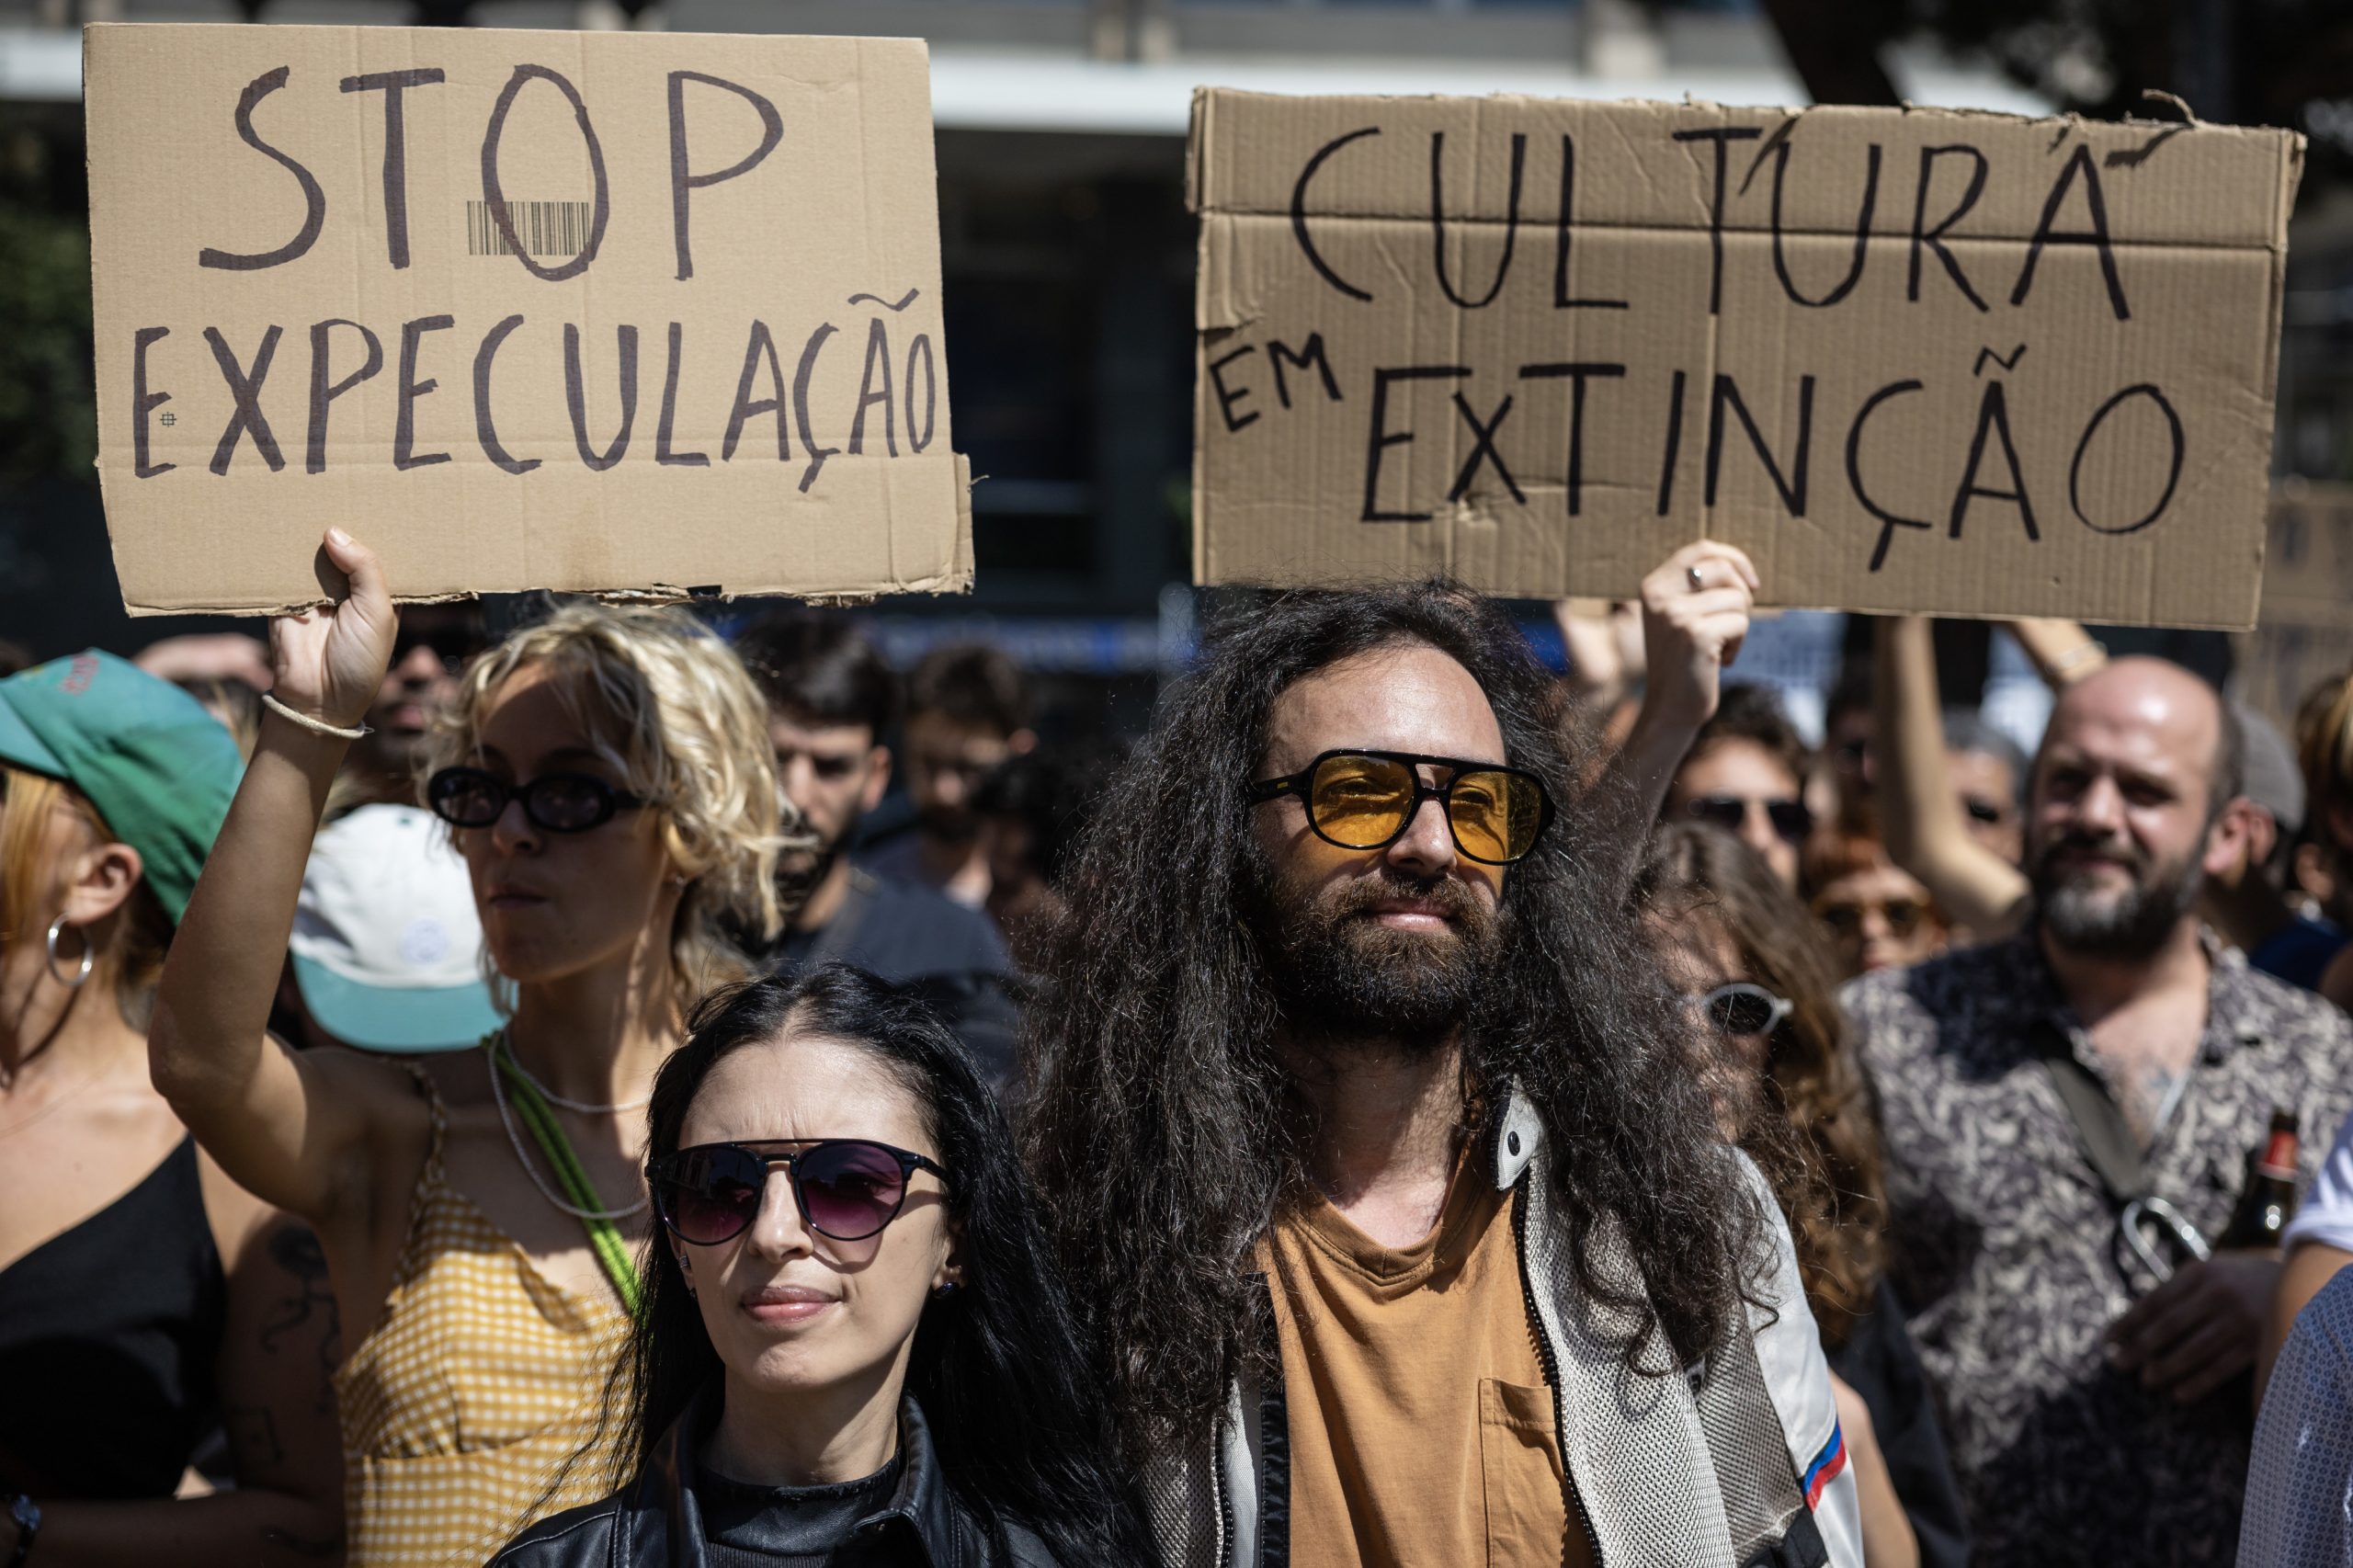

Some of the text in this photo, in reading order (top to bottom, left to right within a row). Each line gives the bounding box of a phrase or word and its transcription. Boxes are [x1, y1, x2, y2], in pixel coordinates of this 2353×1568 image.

[199, 64, 784, 282] STOP
[1291, 126, 2131, 321] CULTURA
[133, 288, 936, 494] EXPECULAÇÃO
[1209, 332, 1343, 433] EM
[1360, 344, 2187, 573] EXTINÇÃO
